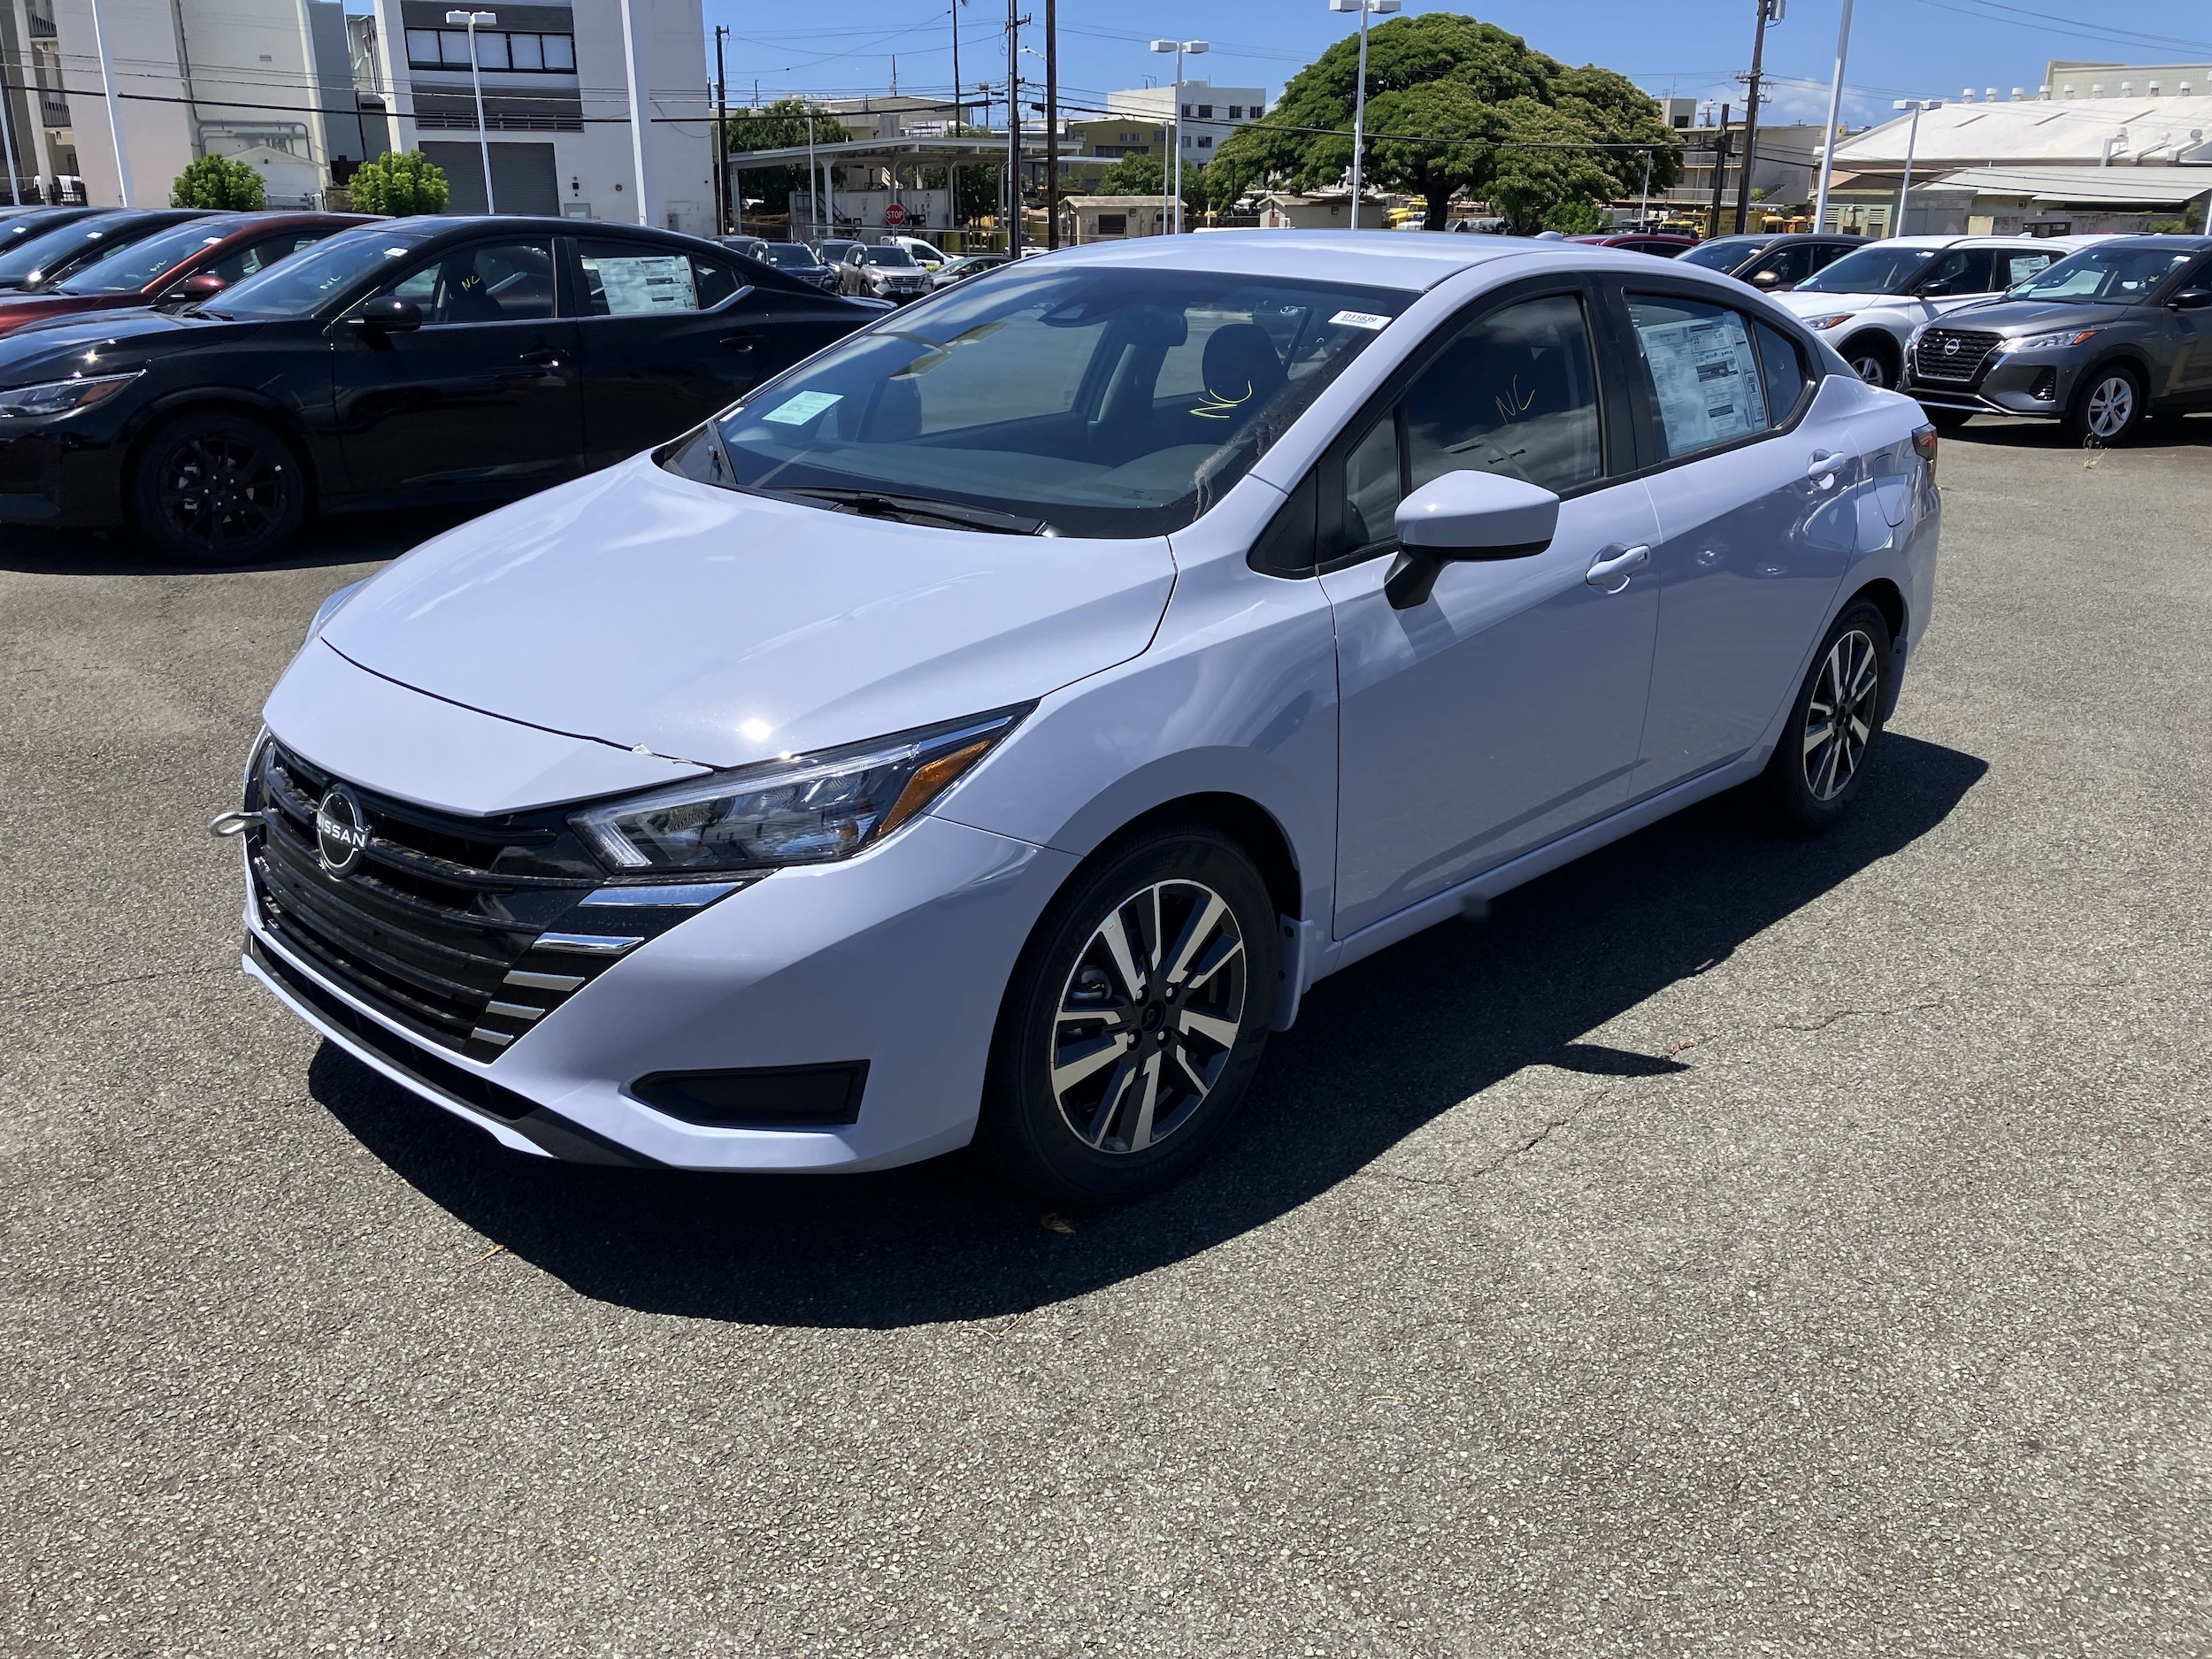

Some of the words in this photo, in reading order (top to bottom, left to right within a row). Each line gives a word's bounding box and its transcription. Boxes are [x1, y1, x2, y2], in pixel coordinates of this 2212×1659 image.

[461, 275, 481, 291] NC
[1188, 380, 1253, 419] NC
[1494, 373, 1536, 427] NC
[317, 811, 366, 847] NISSAN
